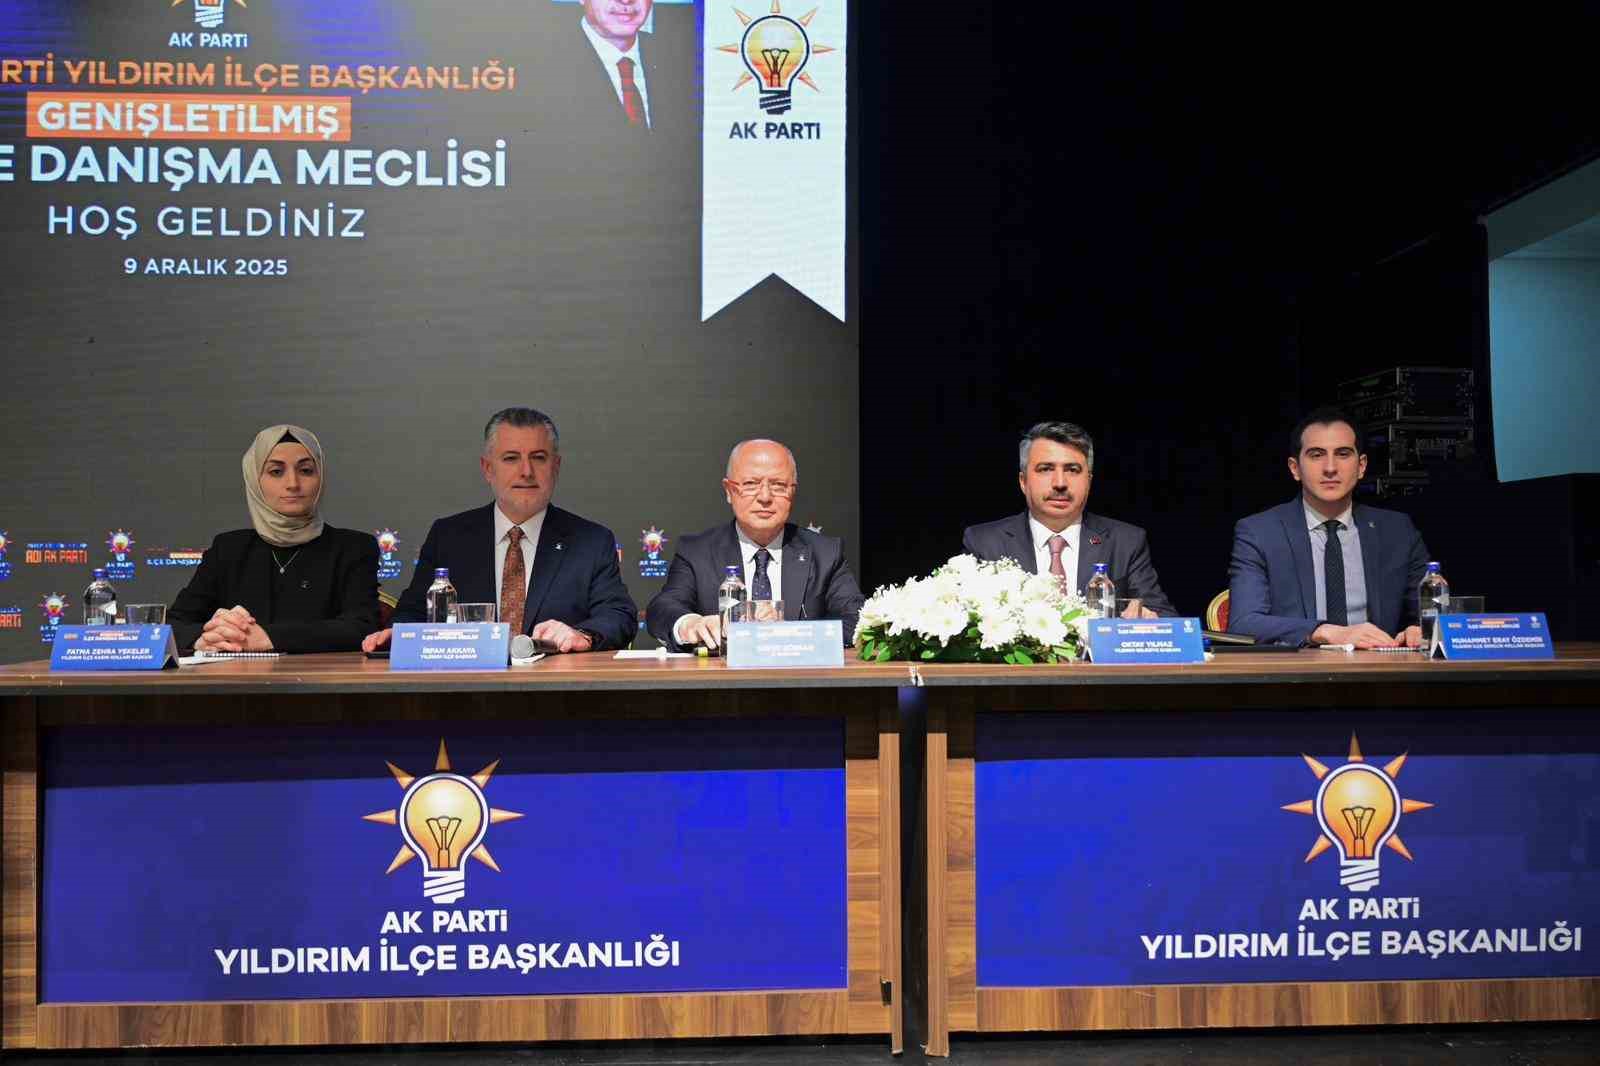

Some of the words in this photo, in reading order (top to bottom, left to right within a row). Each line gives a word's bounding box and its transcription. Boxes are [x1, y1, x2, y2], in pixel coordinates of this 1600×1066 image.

[168, 32, 193, 47] AK
[64, 60, 215, 86] YILDIRIM
[225, 56, 300, 93] İLÇE
[310, 60, 516, 94] BAŞKANLIĞI
[729, 121, 758, 140] AK
[31, 145, 282, 192] DANIŞMA
[296, 138, 506, 187] MECLİSİ
[48, 205, 138, 240] HOŞ
[157, 201, 365, 238] GELDİNİZ
[124, 258, 137, 275] 9
[144, 258, 228, 276] ARALIK
[235, 260, 288, 276] 2025
[380, 911, 423, 934] AK
[1299, 898, 1340, 921] AK
[214, 946, 370, 975] YILDIRIM
[379, 938, 457, 976] İLÇE
[468, 933, 680, 975] BAŞKANLIĞI
[1140, 932, 1289, 960] YILDIRIM
[1298, 924, 1371, 961] İLÇE
[1381, 920, 1582, 960] BAŞKANLIĞI
